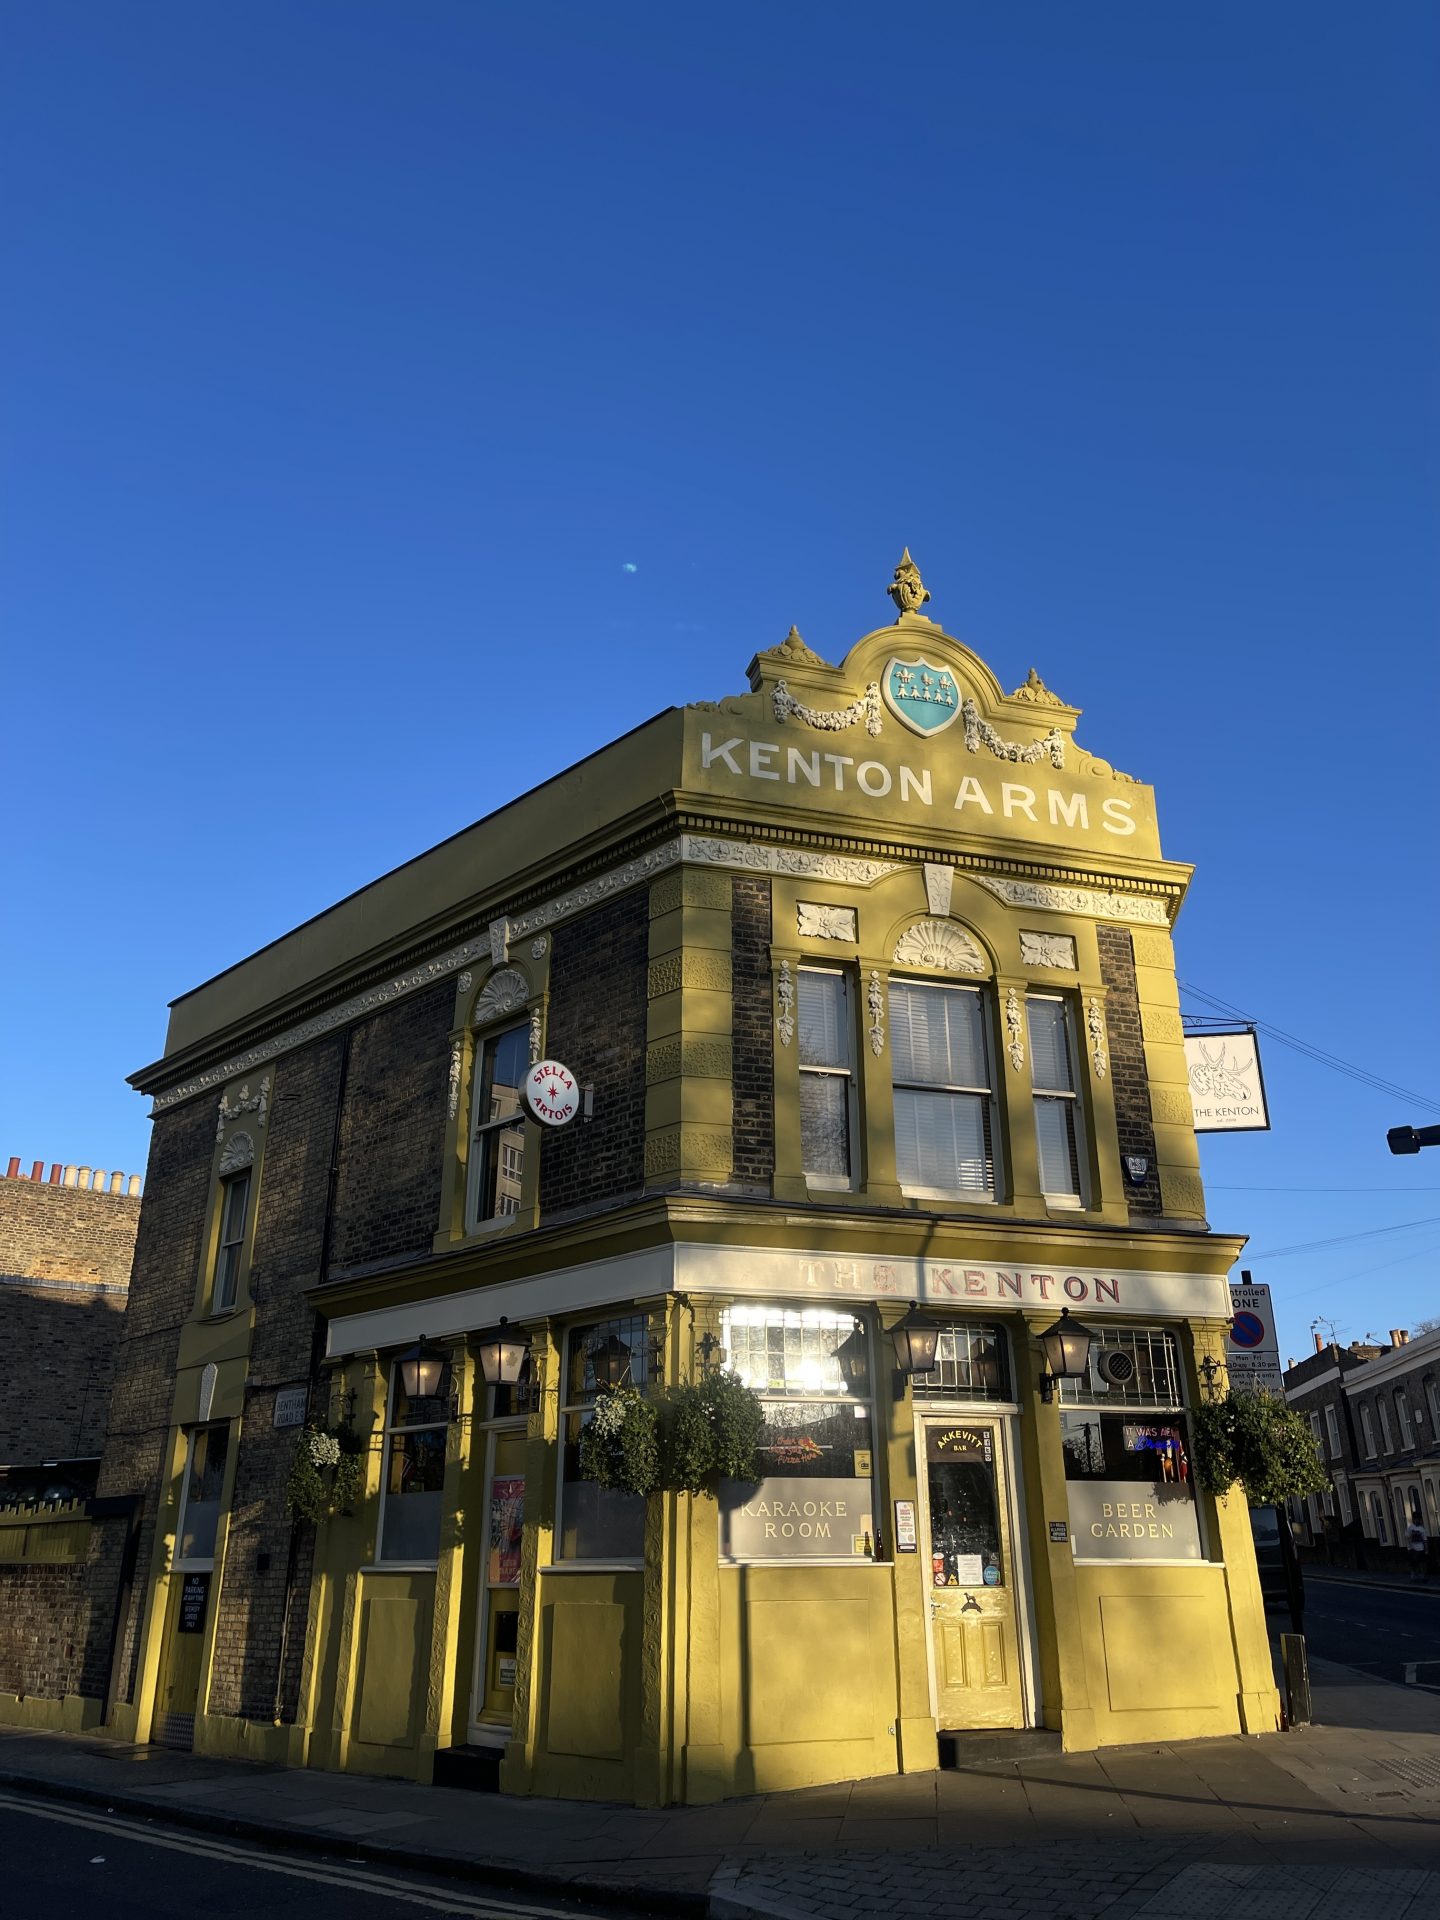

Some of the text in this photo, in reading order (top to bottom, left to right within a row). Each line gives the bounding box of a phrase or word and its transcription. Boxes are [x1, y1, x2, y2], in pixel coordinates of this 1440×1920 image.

[701, 732, 1137, 836] KENTON ARMS
[533, 1065, 573, 1090] STELLA
[533, 1097, 573, 1120] ARTOIS
[1194, 1106, 1259, 1118] THE KENTON
[799, 1259, 1121, 1303] THE KENTON
[1229, 1288, 1266, 1297] ntrolled
[1232, 1298, 1260, 1309] ONE
[276, 1398, 305, 1411] BENTHAM
[276, 1412, 294, 1424] ROAD
[1125, 1427, 1133, 1436] IT
[1136, 1427, 1158, 1437] WAS
[937, 1430, 983, 1449] AKKEVITT
[1127, 1439, 1135, 1449] A
[741, 1501, 847, 1517] KARAOKE
[1102, 1503, 1156, 1518] BEER
[764, 1522, 832, 1538] ROOM
[1091, 1523, 1174, 1538] GARDEN
[191, 1577, 200, 1585] NO
[184, 1586, 205, 1594] PARKING
